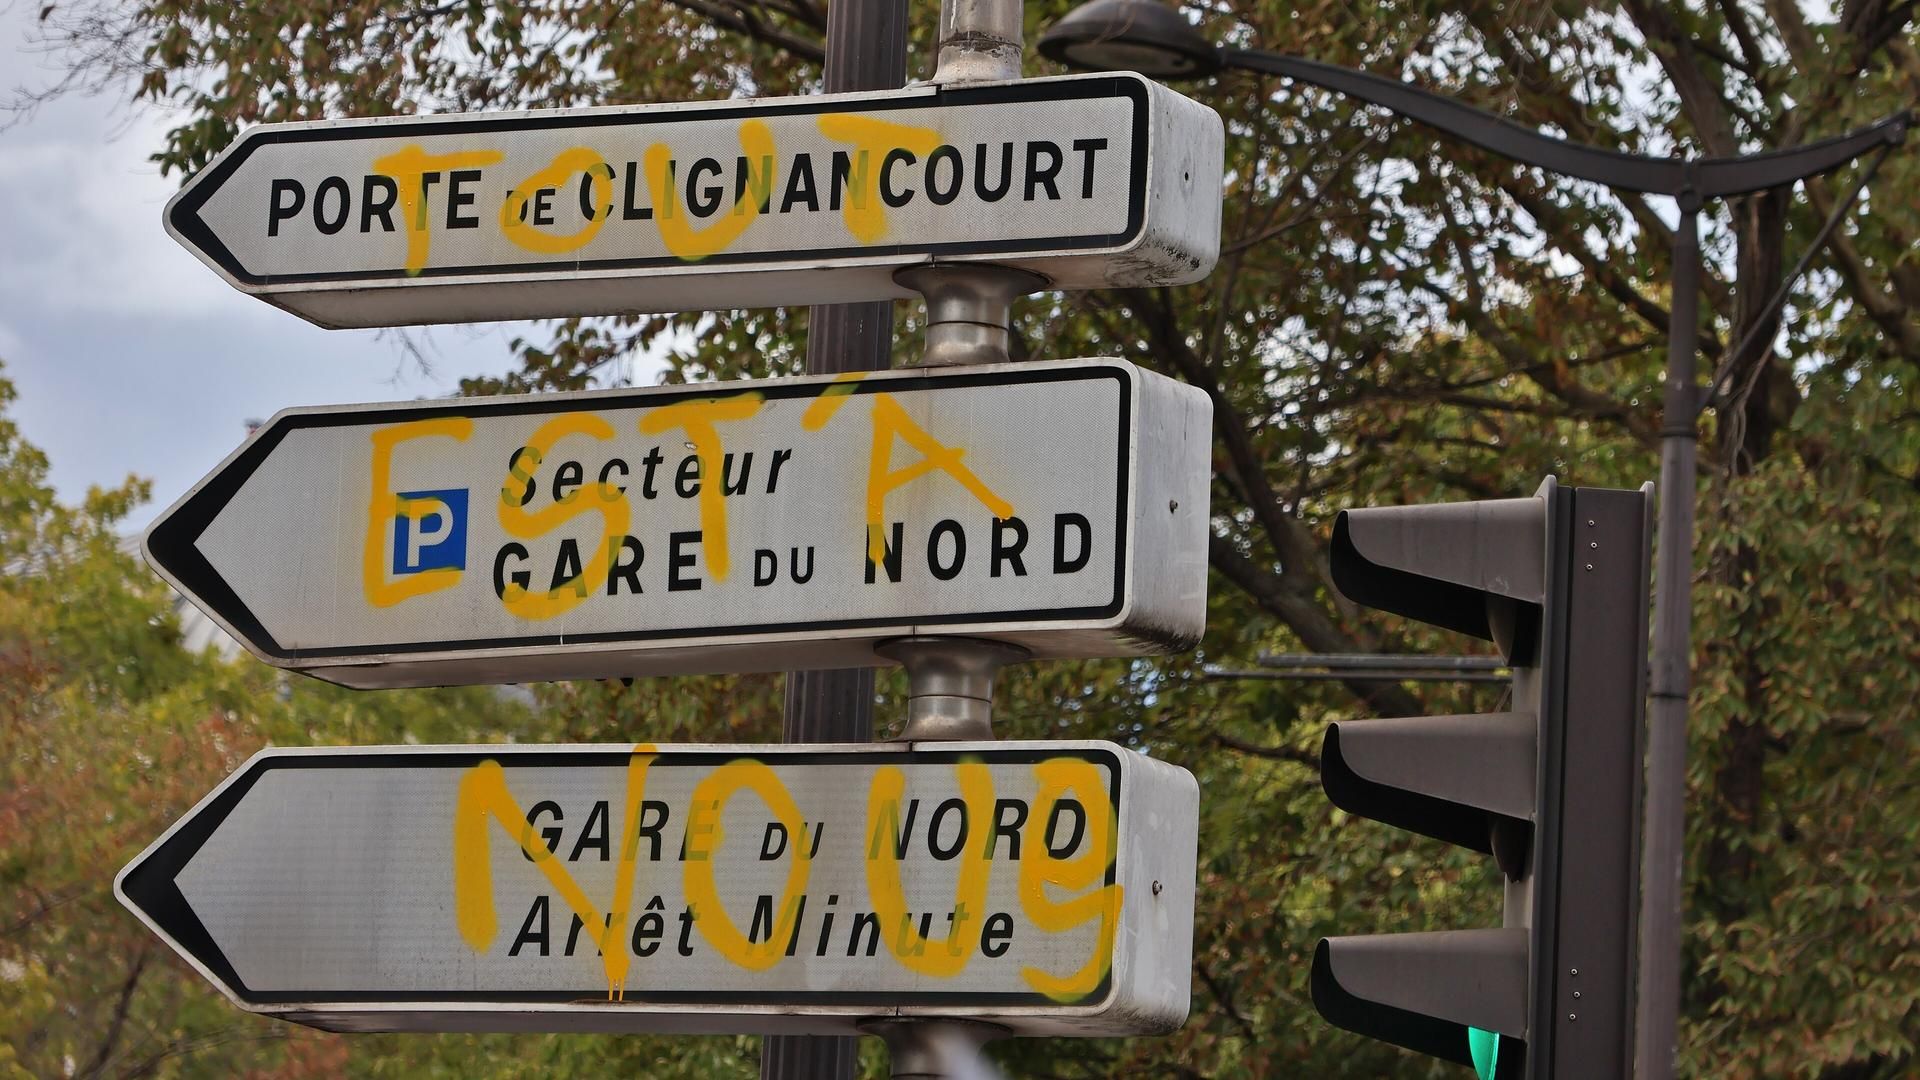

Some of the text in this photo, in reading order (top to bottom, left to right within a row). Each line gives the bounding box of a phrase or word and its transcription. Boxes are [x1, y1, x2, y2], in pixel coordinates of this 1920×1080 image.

[268, 138, 1108, 237] PORTE DE CLIGNANCOURT
[372, 113, 943, 275] TOUT
[501, 444, 792, 508] Secteur
[493, 512, 1093, 603] GARE DU NORD
[520, 798, 1087, 862] GARE DU NORD
[508, 894, 1015, 958] Arrêt Minute
